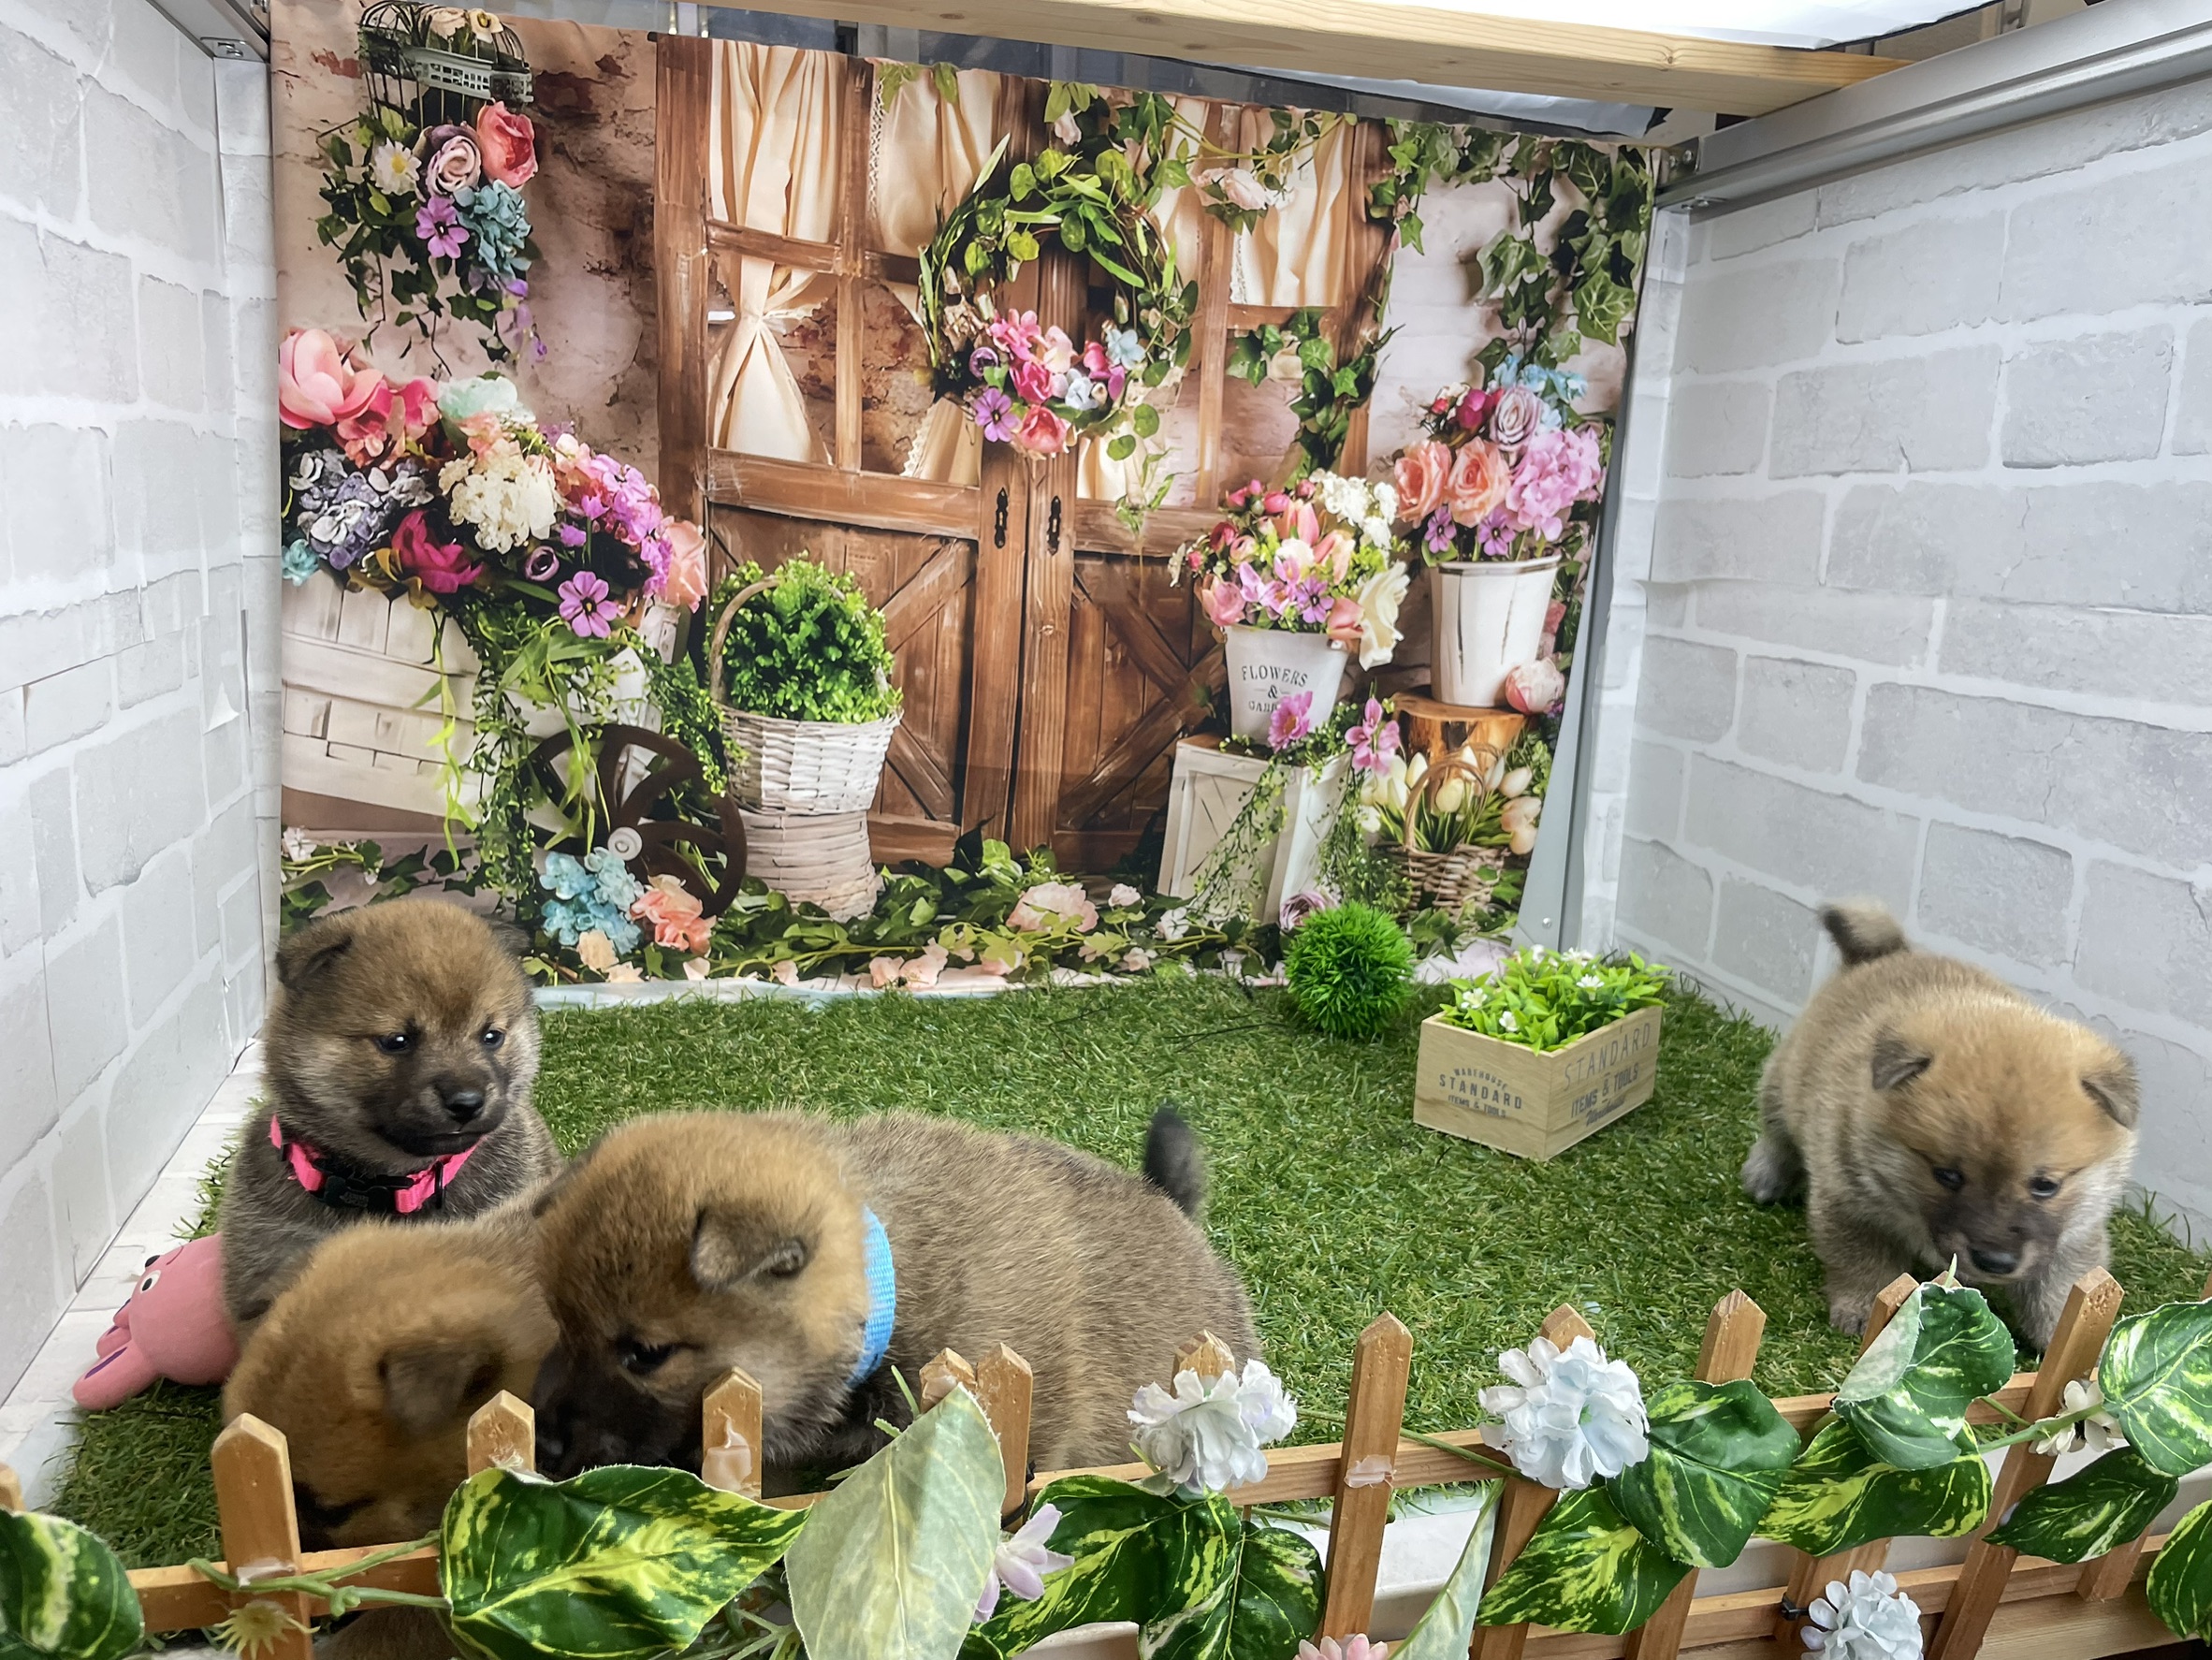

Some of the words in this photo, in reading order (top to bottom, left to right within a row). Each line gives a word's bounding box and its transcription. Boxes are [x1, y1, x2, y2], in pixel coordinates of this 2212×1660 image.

[1242, 665, 1308, 687] FLOWERS
[1268, 684, 1278, 699] &
[1564, 1023, 1651, 1092] STANDARD
[1440, 1074, 1521, 1109] STANDARD
[1571, 1088, 1597, 1118] ITEMS
[1602, 1078, 1609, 1097] &
[1614, 1062, 1639, 1092] TOOLS
[1448, 1095, 1469, 1108] ITEMS
[1484, 1104, 1506, 1118] TOOLS
